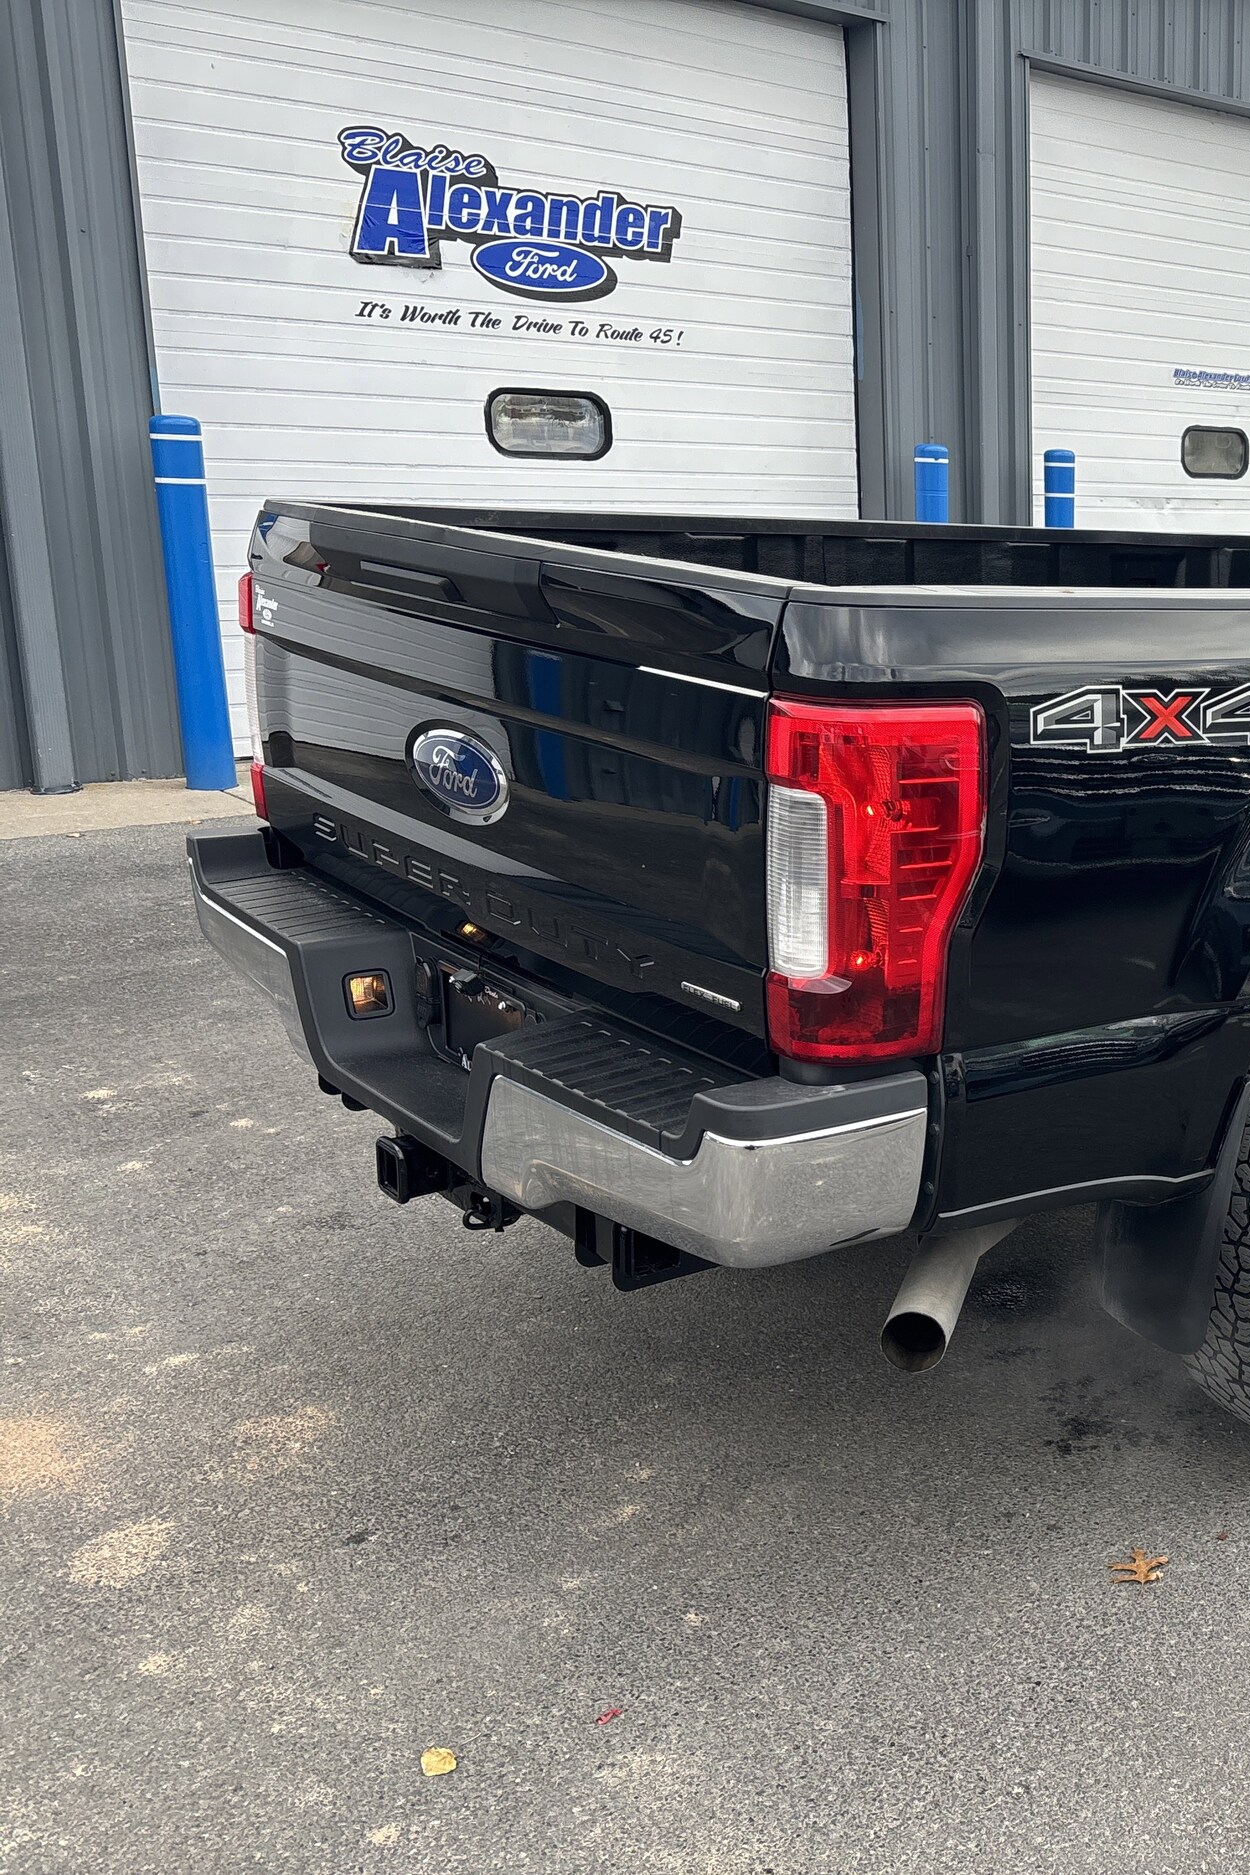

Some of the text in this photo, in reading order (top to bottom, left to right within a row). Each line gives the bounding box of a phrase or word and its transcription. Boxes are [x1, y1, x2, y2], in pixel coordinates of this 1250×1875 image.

[341, 129, 486, 178] Blaise
[353, 165, 673, 258] Alexander
[505, 247, 578, 282] Ford
[355, 301, 392, 320] It's
[400, 305, 462, 326] Worth
[468, 311, 502, 330] The
[511, 315, 563, 335] Drive
[568, 320, 590, 337] To
[595, 323, 643, 342] Route
[428, 745, 479, 798] Ford
[313, 812, 655, 979] SUPER DUTY
